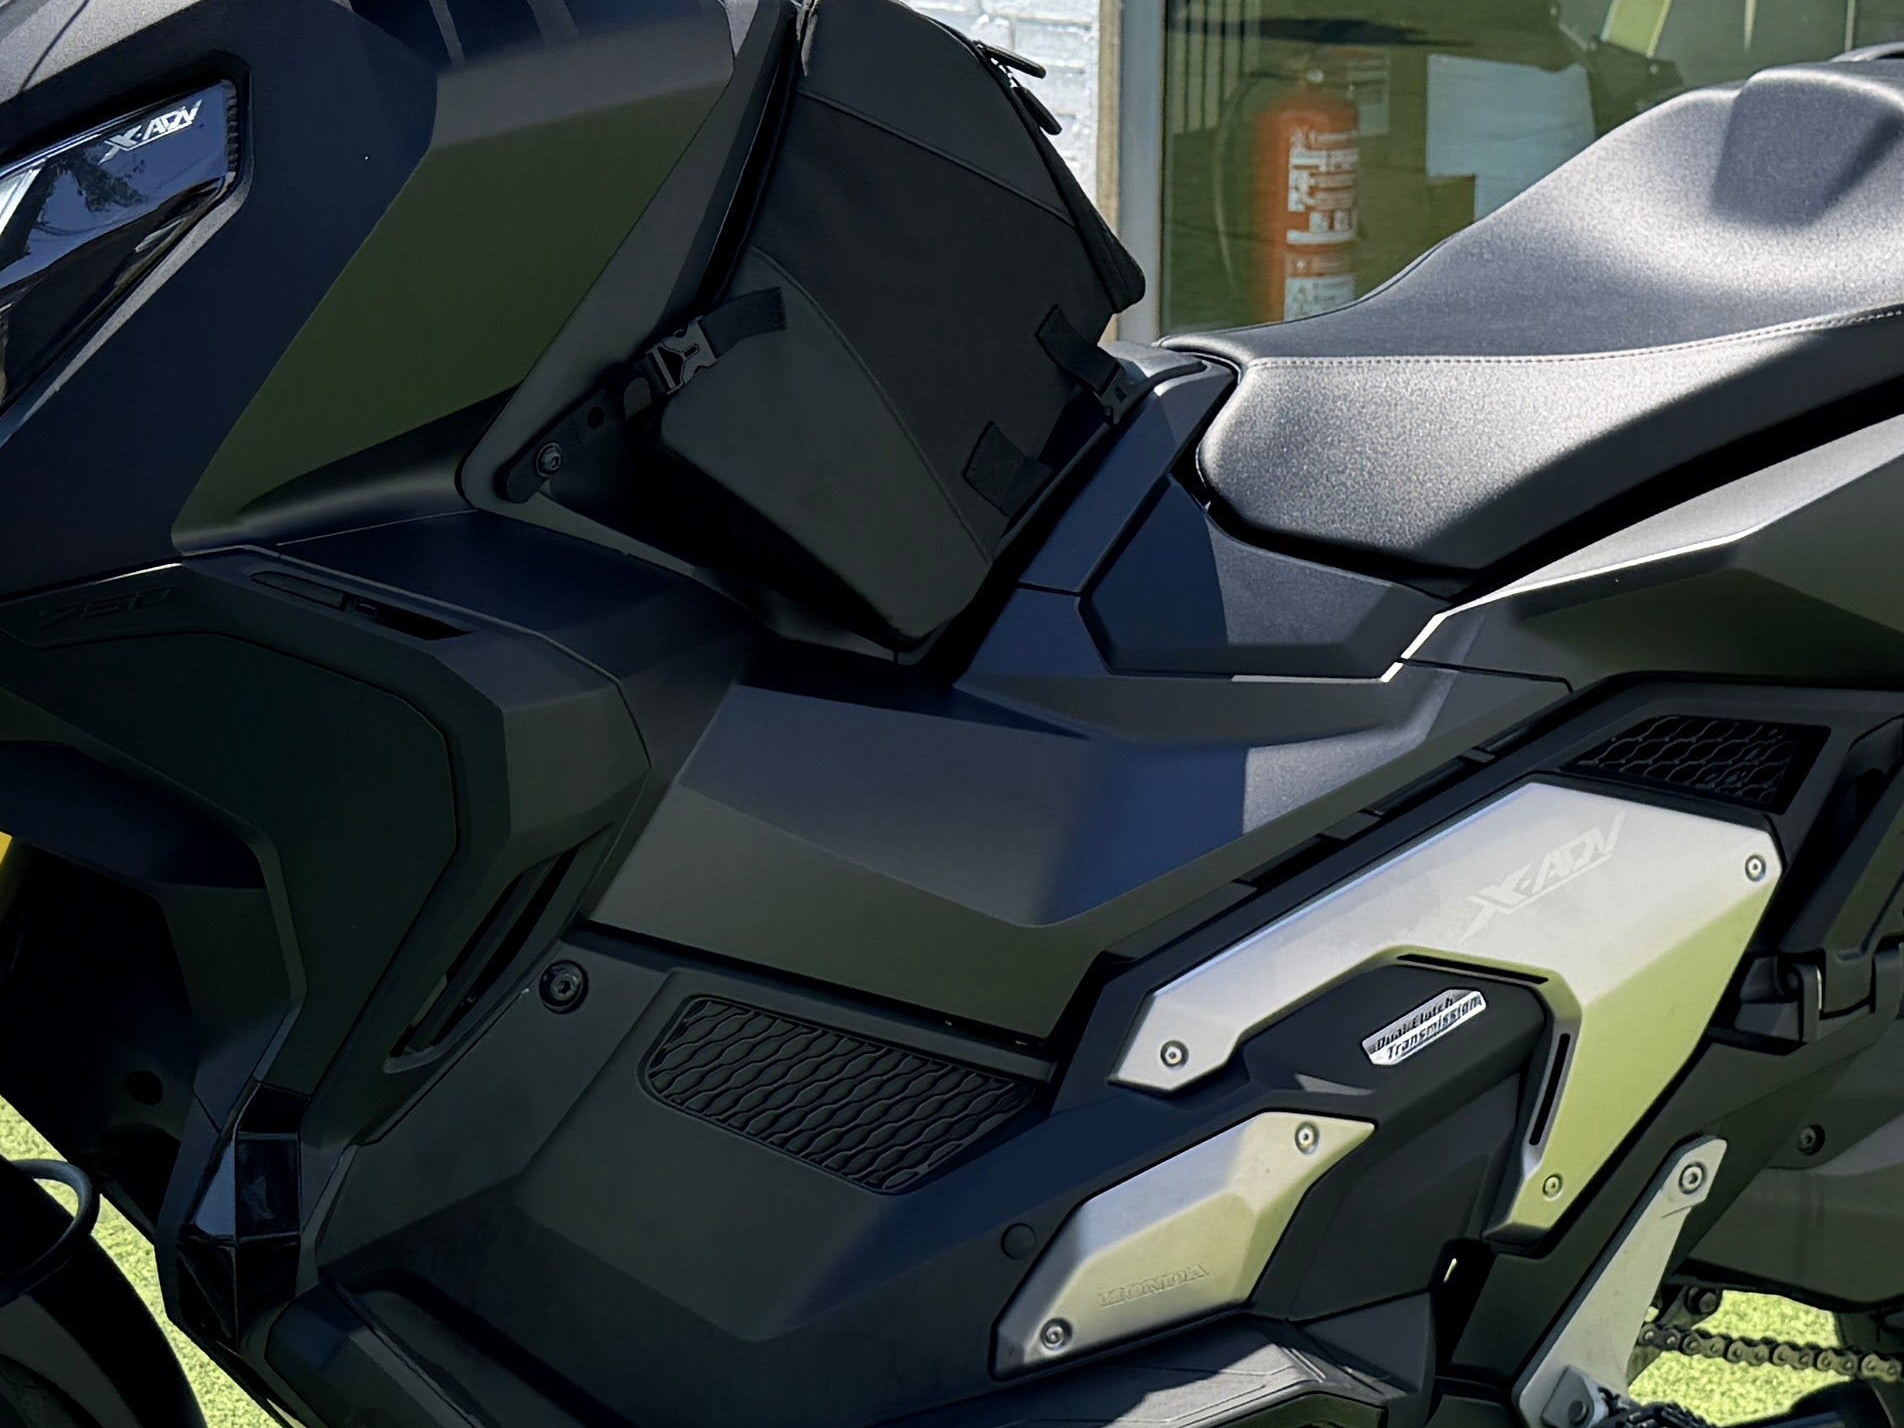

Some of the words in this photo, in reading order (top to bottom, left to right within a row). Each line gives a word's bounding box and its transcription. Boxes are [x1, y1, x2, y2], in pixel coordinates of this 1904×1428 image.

[97, 98, 203, 166] X-ADV
[1456, 810, 1627, 946] X-ADV
[1387, 994, 1484, 1060] Transmission
